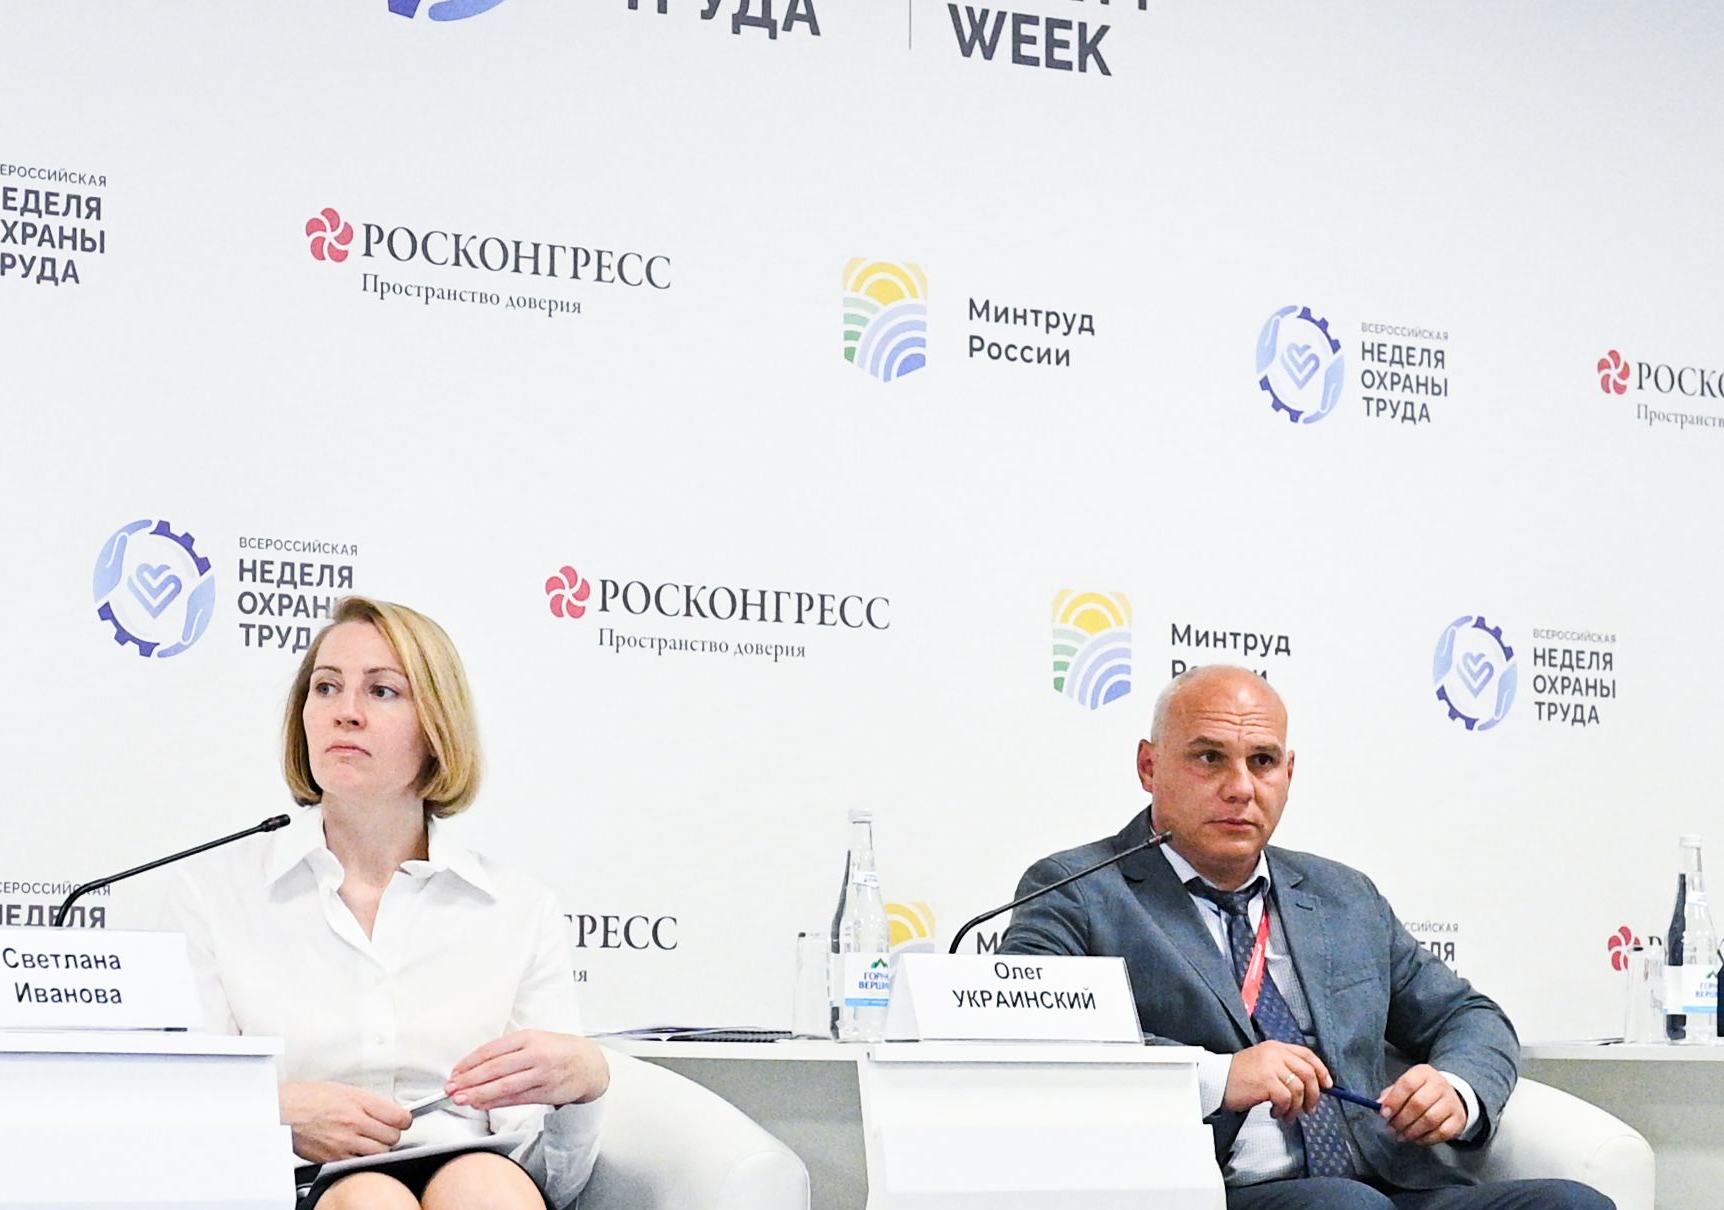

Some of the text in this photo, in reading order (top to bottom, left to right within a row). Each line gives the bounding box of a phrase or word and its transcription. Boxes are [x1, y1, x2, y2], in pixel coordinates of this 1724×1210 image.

[948, 3, 1111, 76] WEEK
[362, 224, 670, 289] РОСКОНГРЕСС
[363, 274, 580, 317] Пространство доверия
[970, 298, 1094, 336] Минтруд
[1361, 323, 1448, 341] ВСЕРОССИЙСКАЯ
[969, 335, 1069, 366] России
[1362, 341, 1444, 369] НЕДЕЛЯ
[1361, 369, 1447, 397] ОХРАНЫ
[1362, 397, 1430, 424] ТРУДА
[240, 537, 357, 555] ВСЕРОССИЙСКАЯ
[239, 559, 352, 589] НЕДЕЛЯ
[237, 591, 337, 619] ОХРАН
[599, 580, 889, 629] РОСКОНГРЕСС
[239, 623, 311, 653] ТРУД
[600, 628, 804, 662] Пространство доверия
[1172, 624, 1290, 657] Минтруд
[1533, 628, 1616, 643] ВСЕРОССИЙСКАЯ
[1534, 648, 1612, 672] НЕДЕЛЯ
[1533, 675, 1615, 698] ОХРАНЫ
[1535, 701, 1599, 727] ТРУДА
[3, 948, 121, 969] Светлана
[995, 962, 1042, 979] Олег
[15, 983, 121, 1004] Иванова
[950, 987, 1097, 1010] УКРАИНСКИЙ
